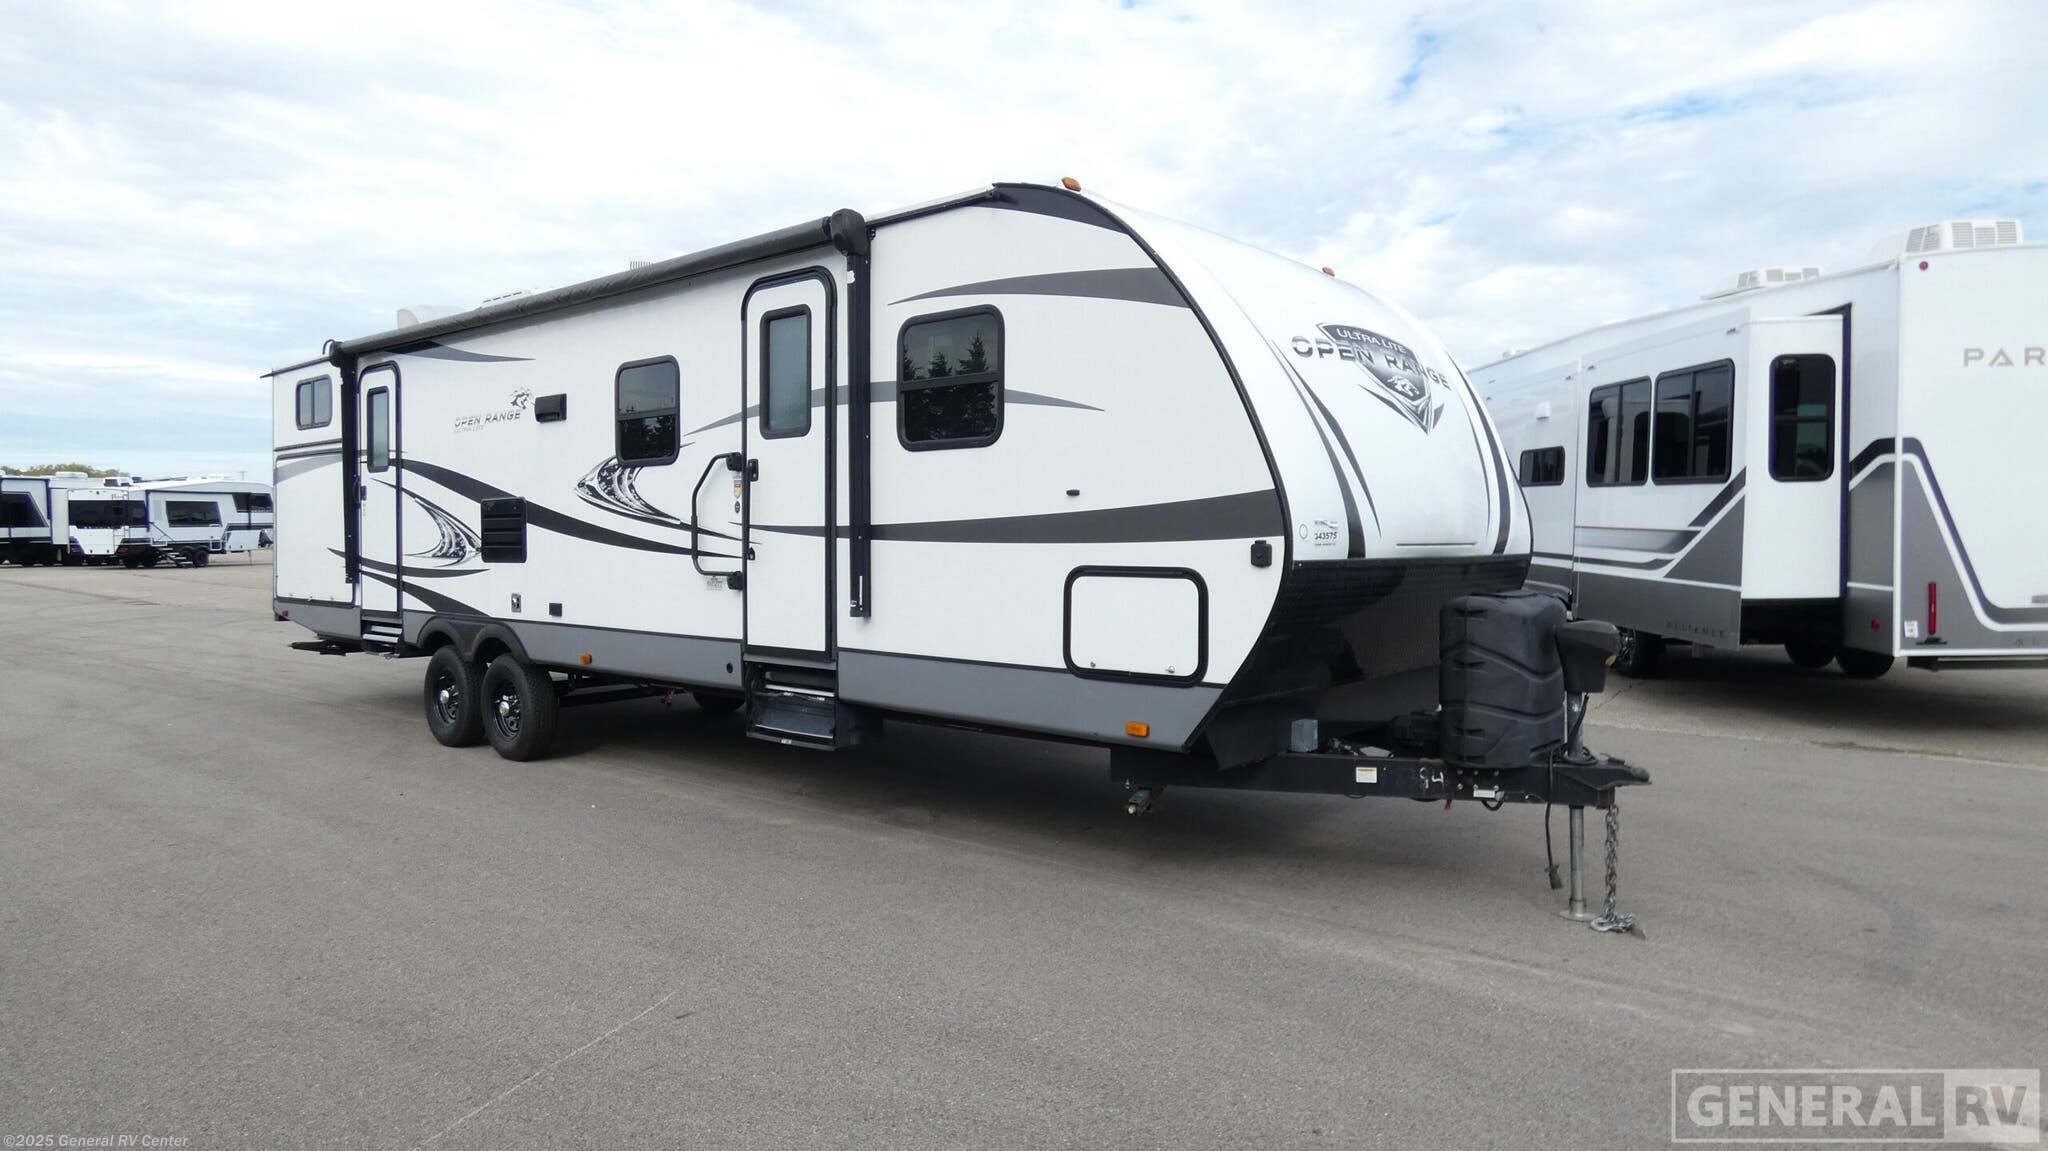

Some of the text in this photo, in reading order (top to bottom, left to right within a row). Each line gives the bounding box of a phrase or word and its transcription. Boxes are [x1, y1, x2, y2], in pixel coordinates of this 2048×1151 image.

[1336, 327, 1407, 354] ULTRA LITE
[1291, 335, 1451, 390] OPEN RANGE
[1963, 347, 2046, 367] PAR
[454, 410, 521, 428] OPEN RANGE
